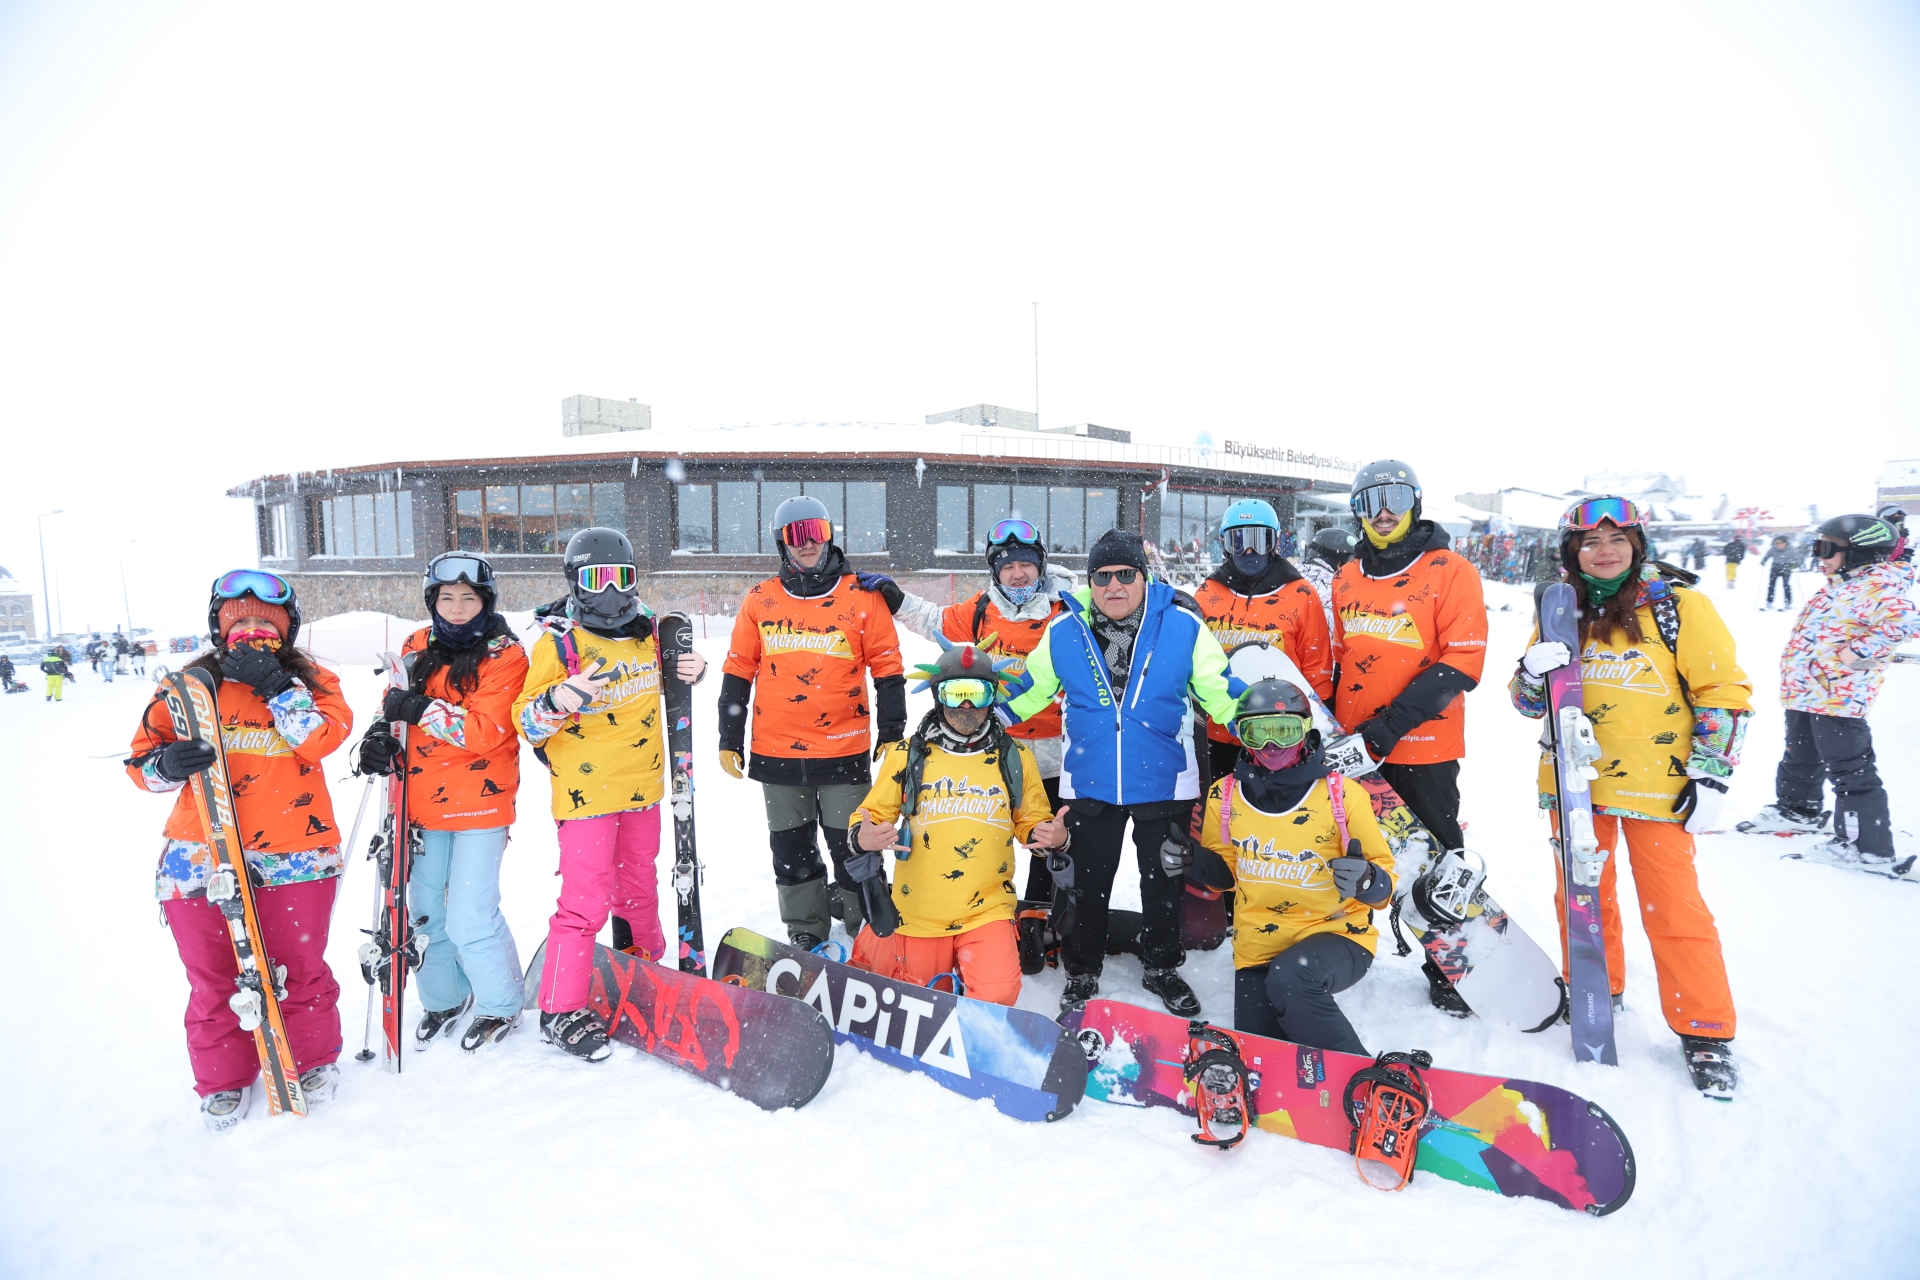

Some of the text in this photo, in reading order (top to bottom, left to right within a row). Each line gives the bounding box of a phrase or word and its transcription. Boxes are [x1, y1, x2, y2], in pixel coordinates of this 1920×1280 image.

[1224, 440, 1285, 461] Büyükşehir
[1287, 449, 1333, 468] Belediyesi
[166, 693, 190, 739] GS
[1587, 992, 1596, 1025] ATOMIC
[1302, 1053, 1315, 1084] Burton
[287, 1081, 300, 1102] 140
